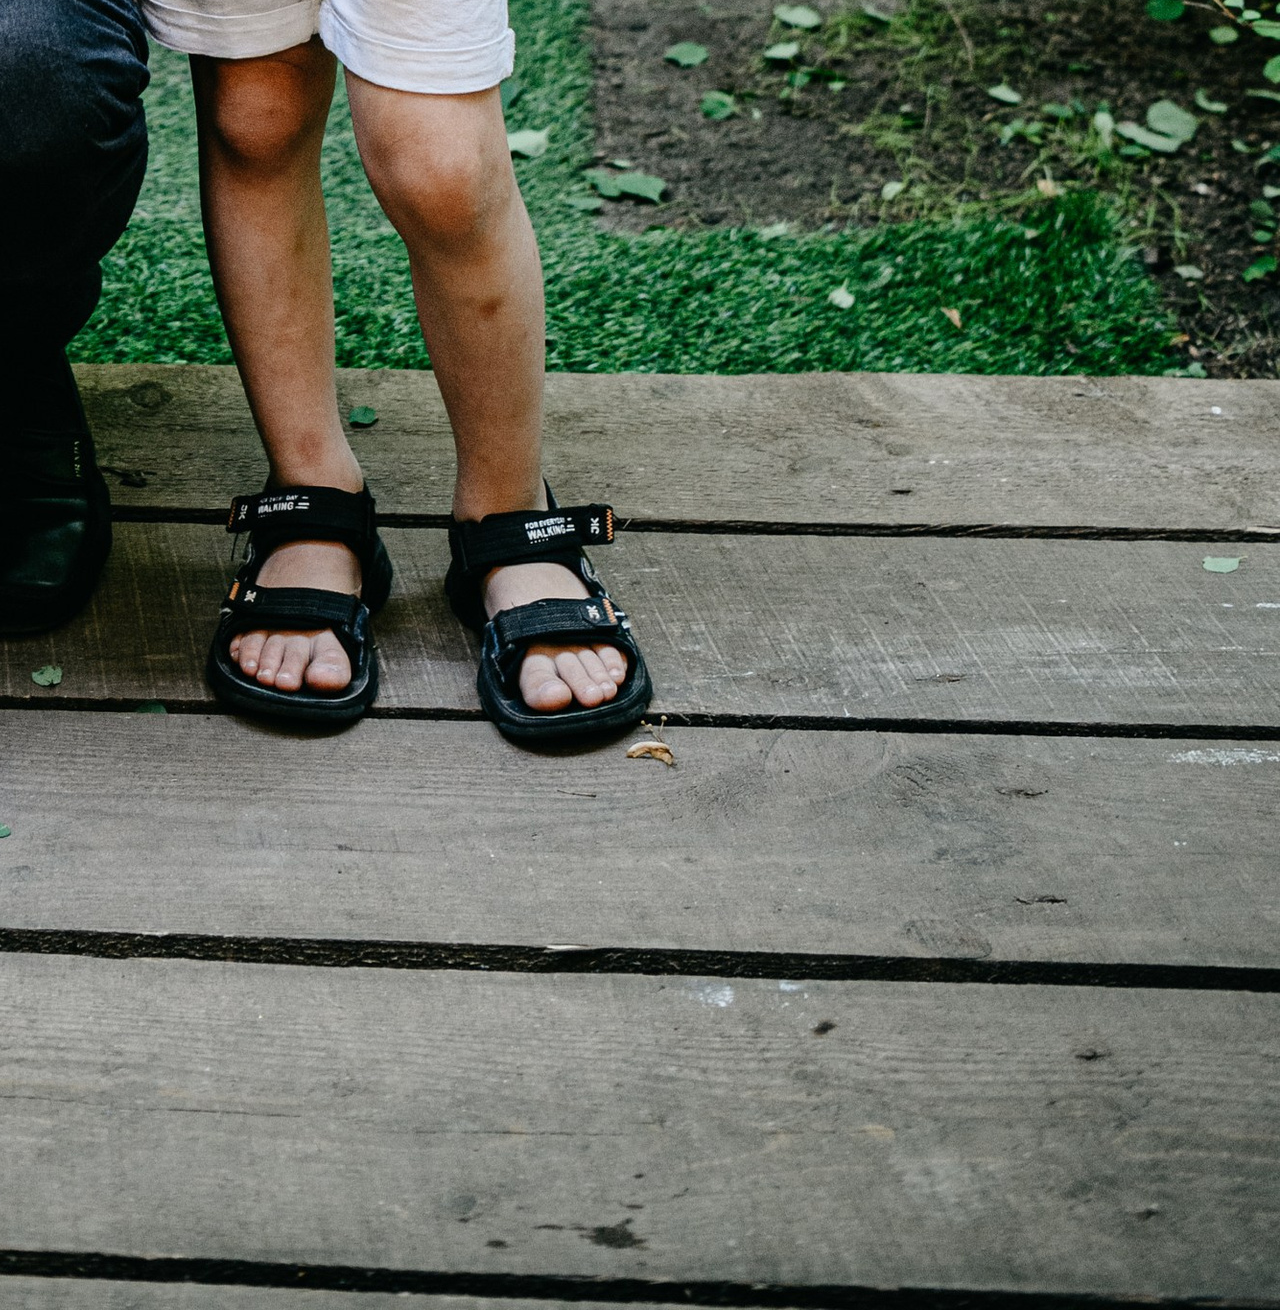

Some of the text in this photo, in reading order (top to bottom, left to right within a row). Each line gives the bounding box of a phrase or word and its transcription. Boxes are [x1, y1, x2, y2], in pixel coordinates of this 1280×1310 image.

[257, 501, 295, 514] WALKING
[524, 521, 539, 530] FOR
[526, 524, 567, 541] WALKING
